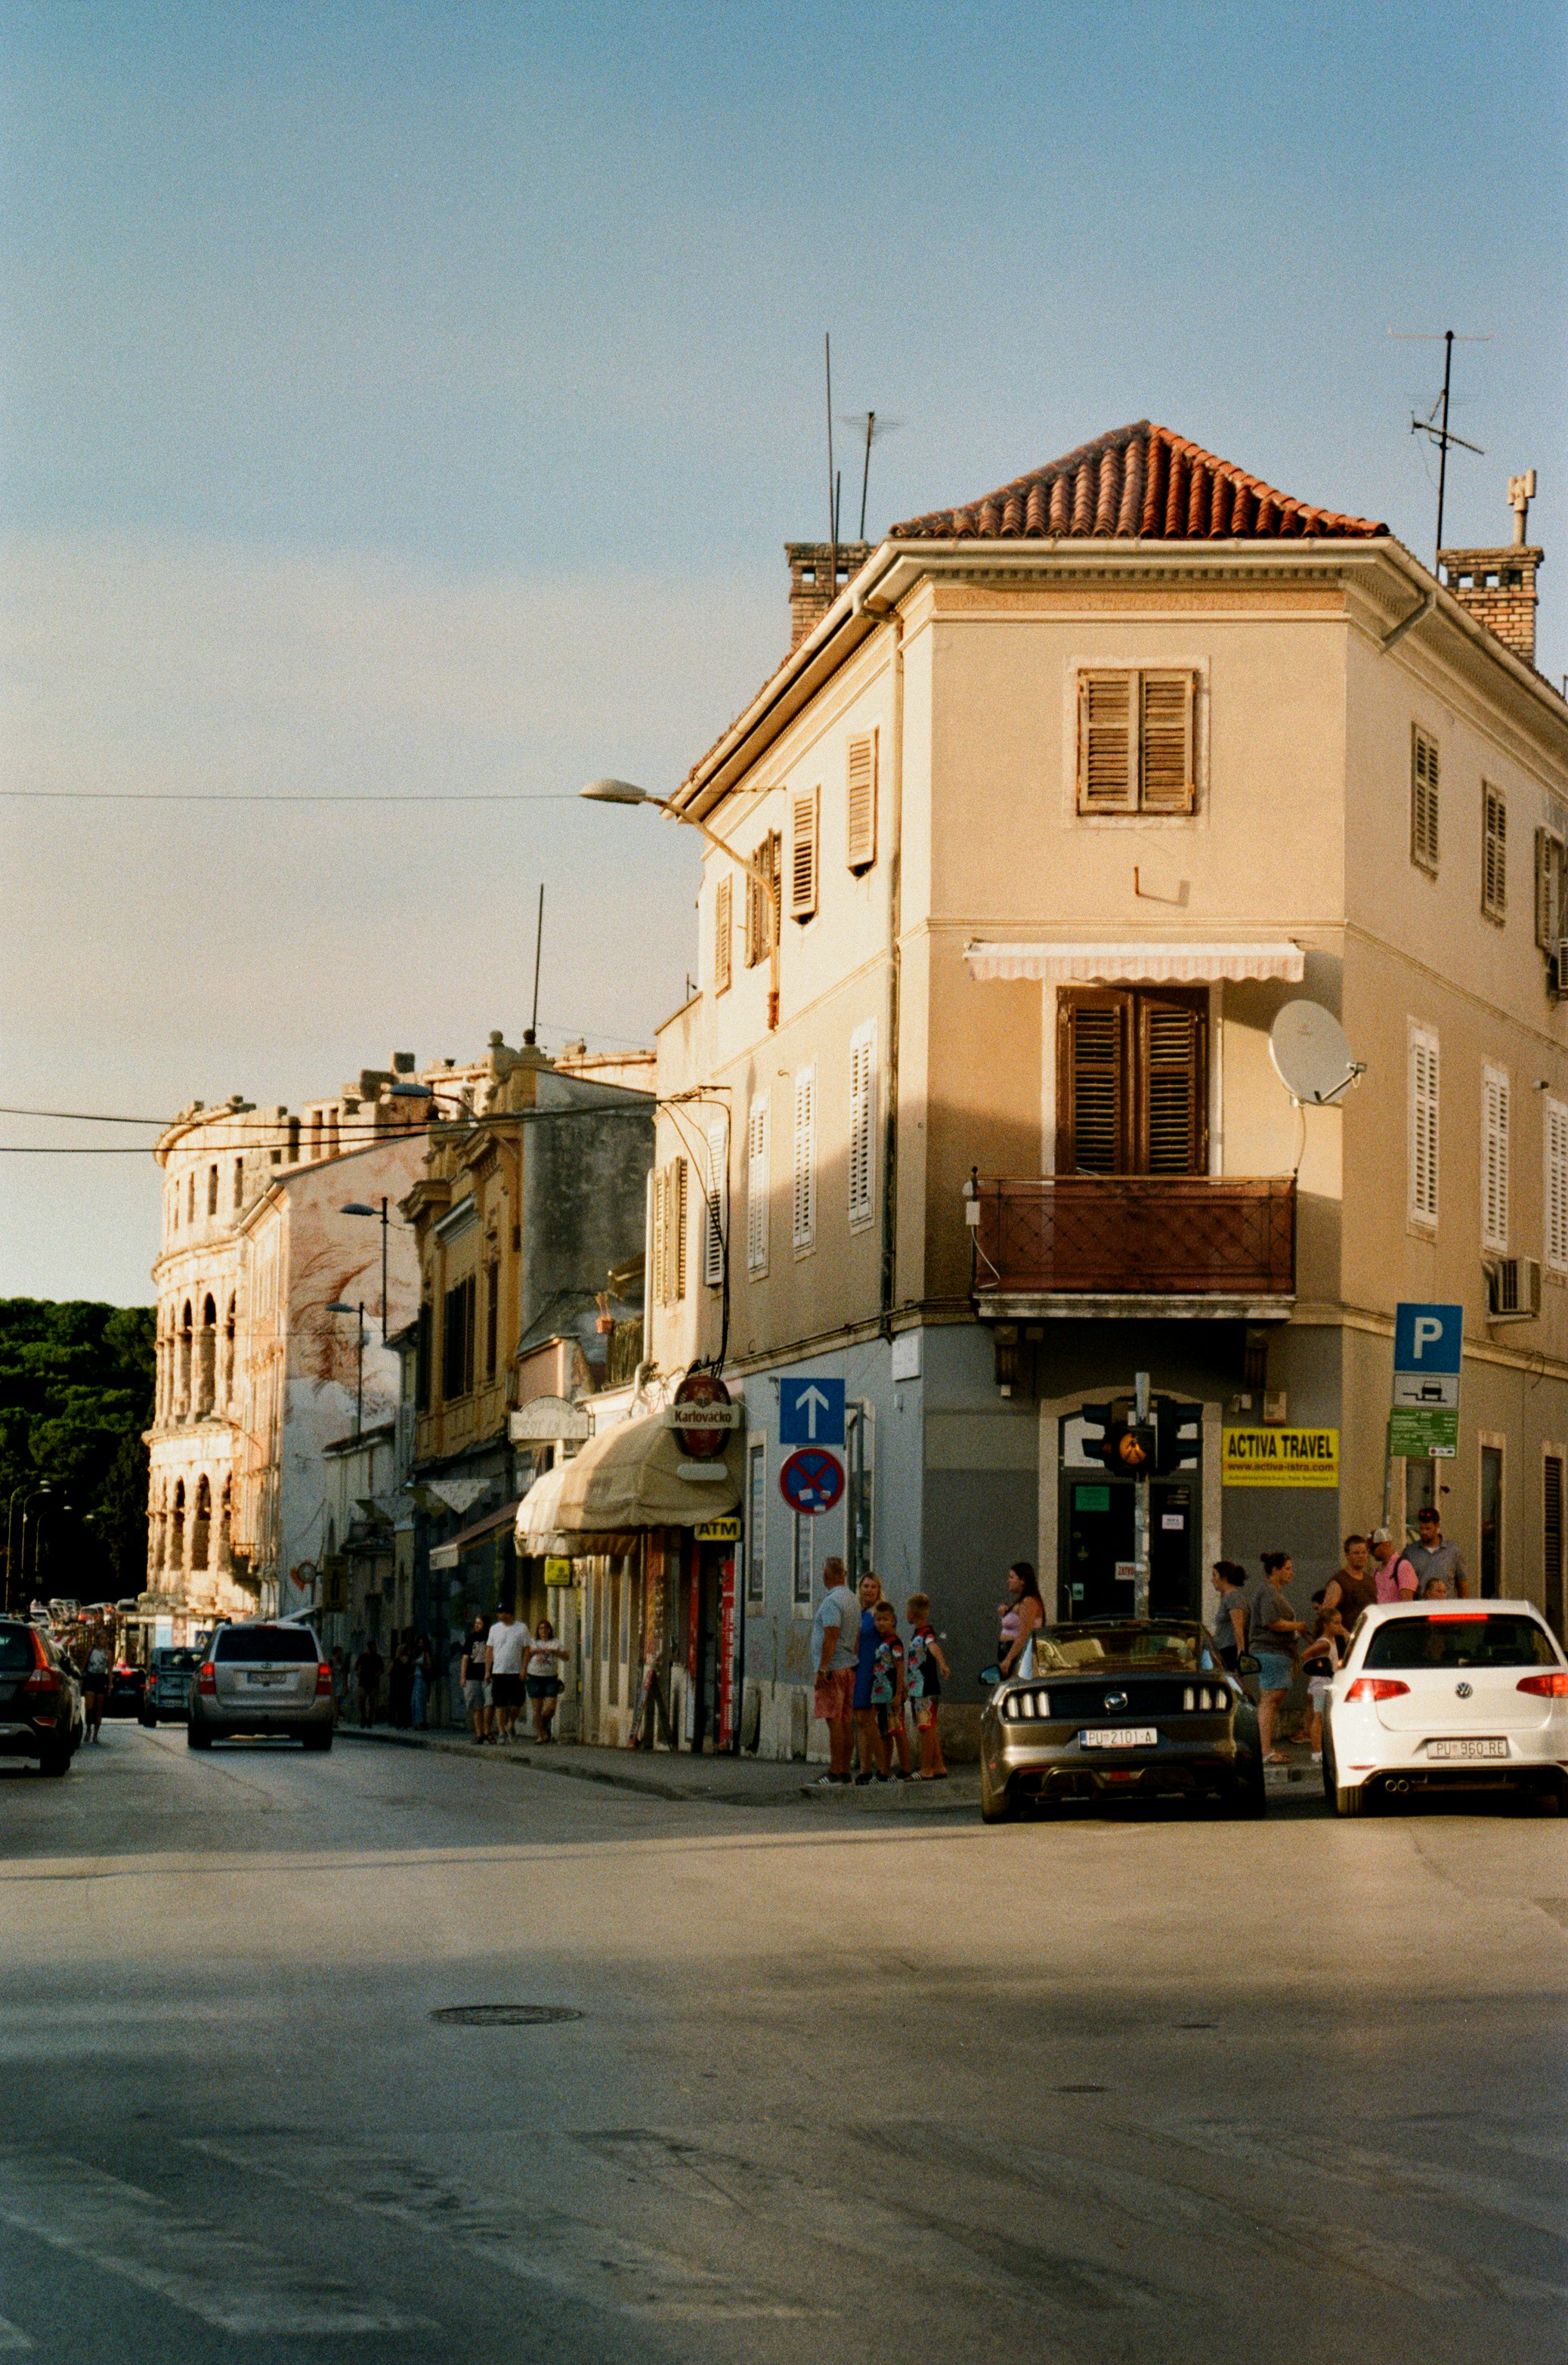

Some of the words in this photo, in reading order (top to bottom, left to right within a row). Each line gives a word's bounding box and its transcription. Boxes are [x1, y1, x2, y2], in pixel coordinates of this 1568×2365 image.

[1414, 1316, 1443, 1359] P
[1228, 1434, 1277, 1458] ACTIVA
[1281, 1434, 1334, 1458] TRAVEL
[1228, 1463, 1334, 1471] www.activa-istra.com
[698, 1523, 737, 1535] ATM
[1089, 1732, 1103, 1745] PU
[1437, 1742, 1451, 1755] PU
